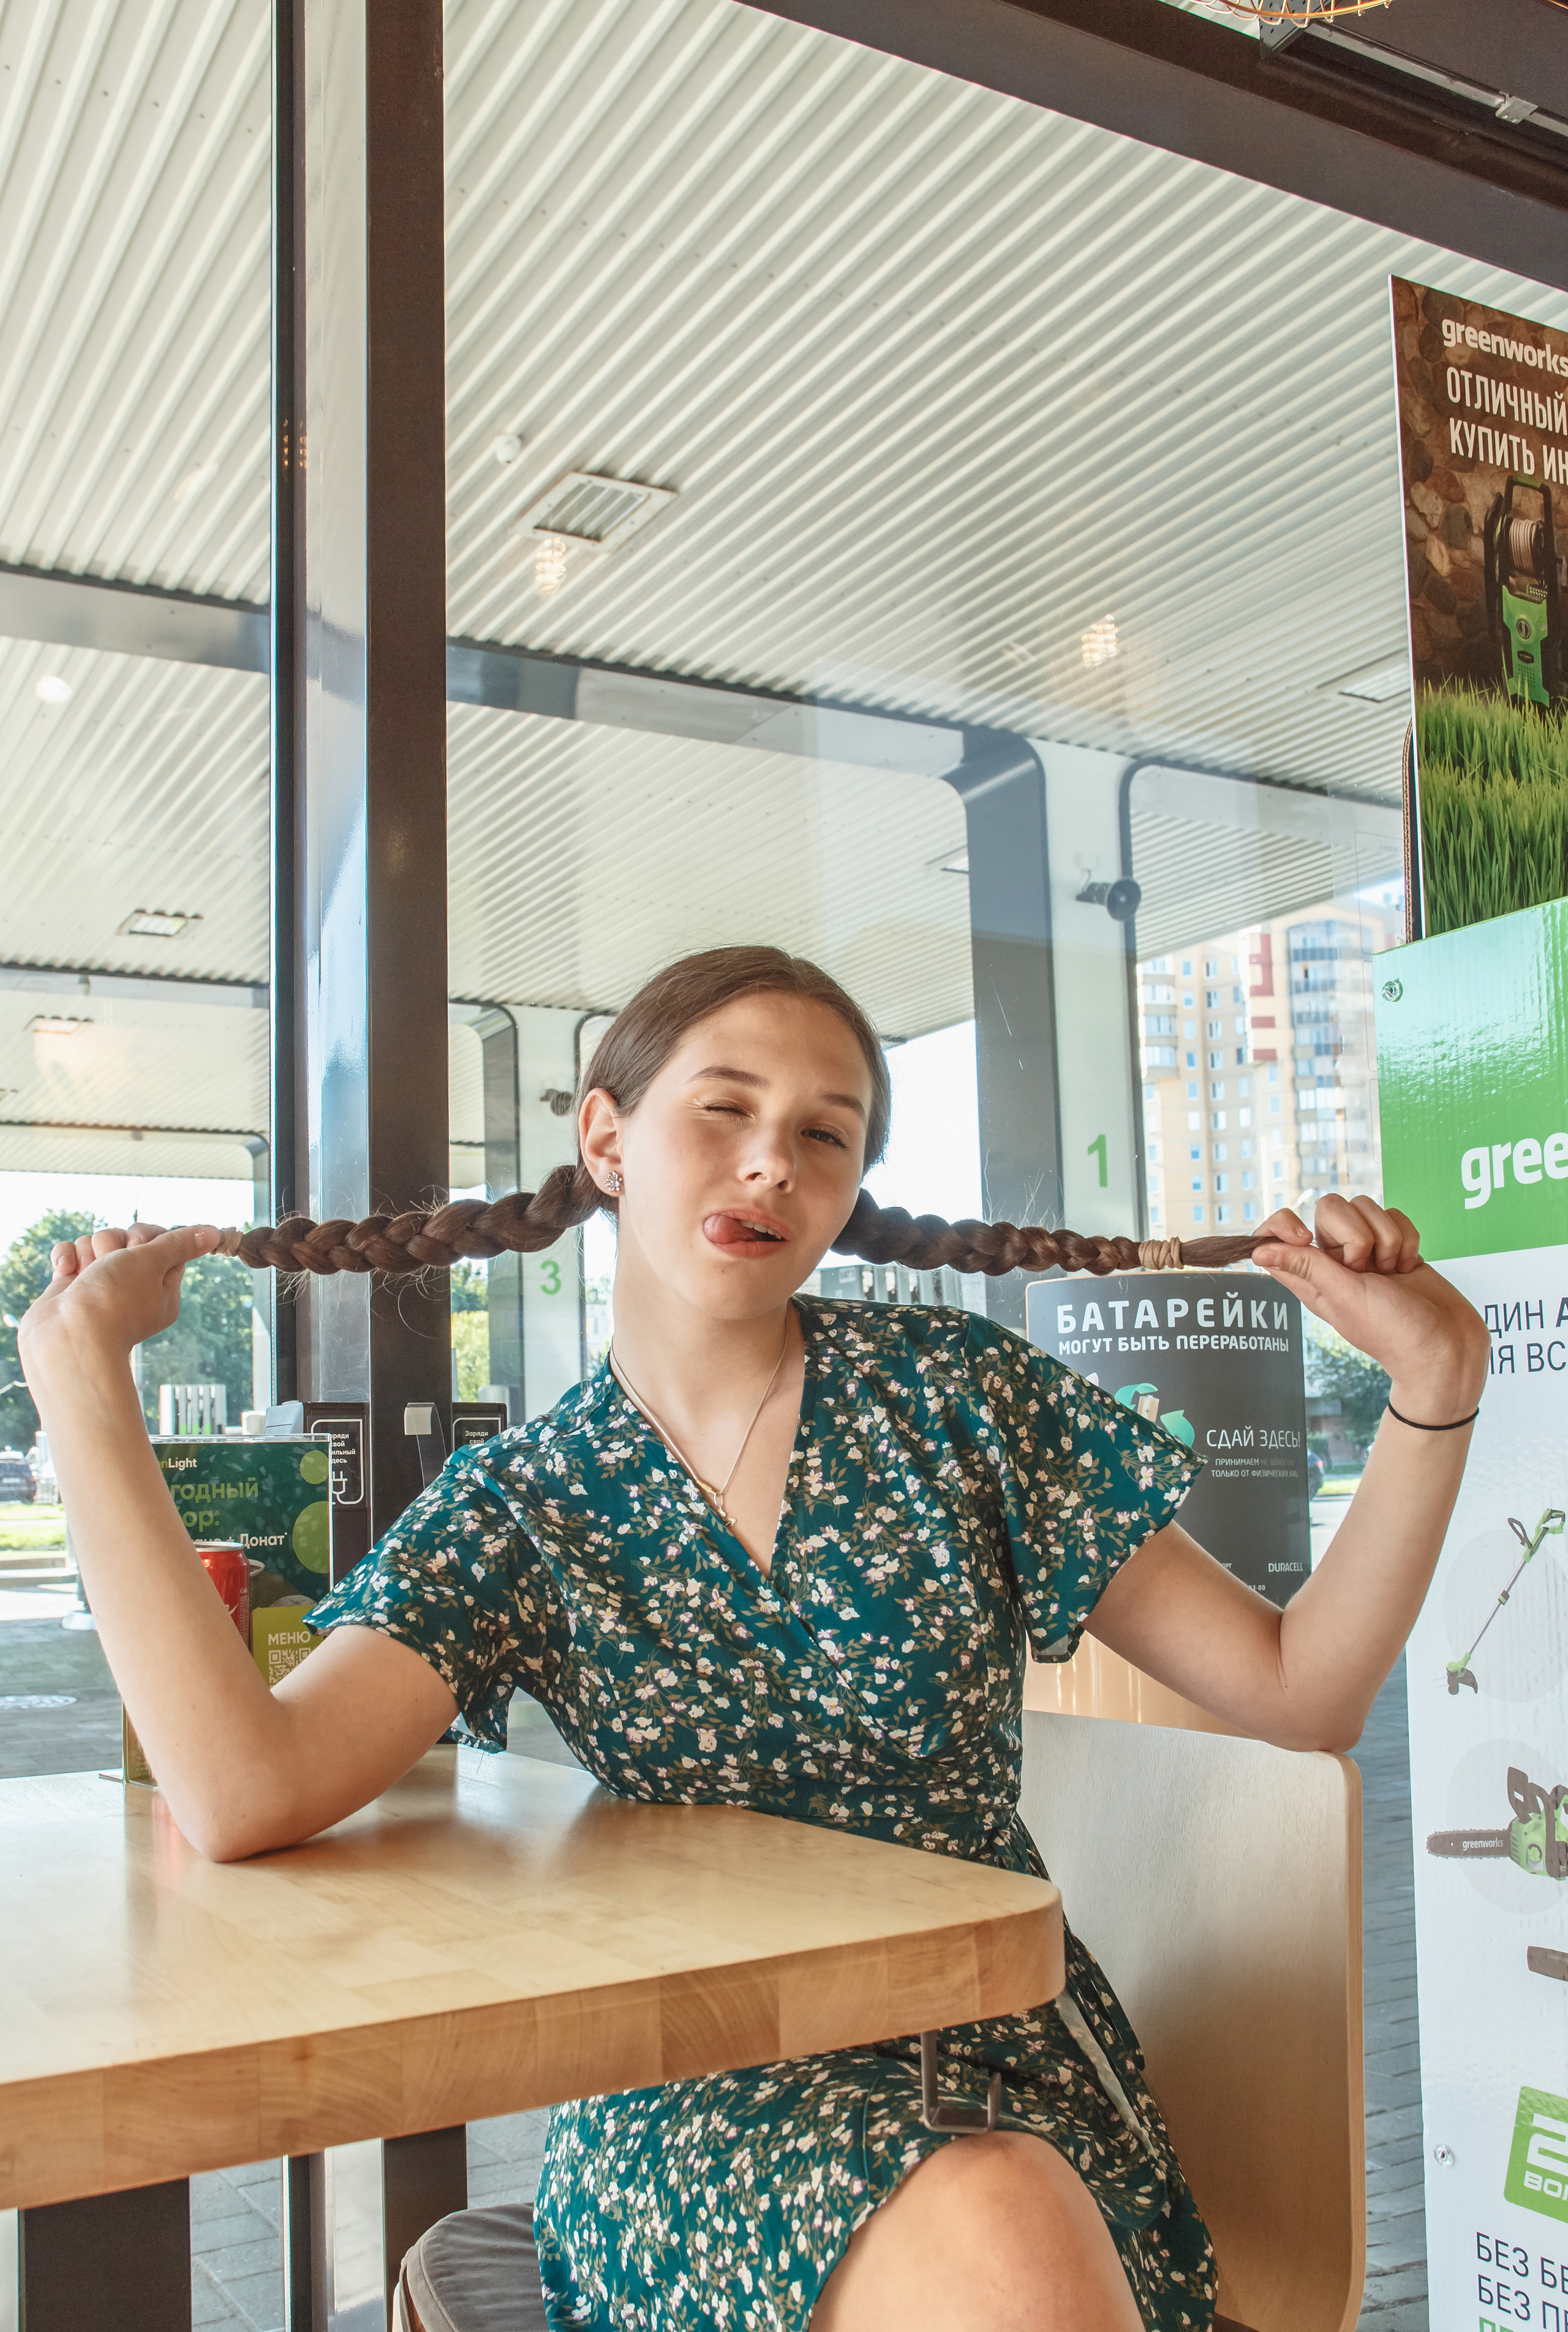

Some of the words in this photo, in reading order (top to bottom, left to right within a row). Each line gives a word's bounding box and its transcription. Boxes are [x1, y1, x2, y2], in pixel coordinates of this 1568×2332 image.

[1442, 319, 1568, 377] greenworks
[1446, 366, 1568, 436] ОТЛИЧНЫЙ
[1449, 417, 1535, 475] КУПИТЬ
[1087, 1134, 1107, 1187] 1
[1461, 1132, 1568, 1209] gree
[540, 1260, 561, 1296] 3
[1057, 1291, 1288, 1334] БАТАРЕЙКИ
[1484, 1299, 1544, 1338] ДИН
[1058, 1338, 1112, 1356] МОГУТ
[1118, 1335, 1170, 1351] БЫТЬ
[1176, 1335, 1289, 1352] ПЕРЕРАБОТАНЫ
[1526, 1340, 1567, 1372] ВС
[1206, 1425, 1254, 1449] СДАЙ
[1259, 1430, 1301, 1450] ЗДЕСЬ!
[159, 1457, 197, 1471] nLight
[170, 1477, 258, 1503] годный
[178, 1507, 220, 1532] ор:
[1268, 1562, 1303, 1572] DURACELL
[268, 1631, 311, 1645] МЕНЮ
[1462, 1837, 1504, 1851] greenworks
[1476, 2231, 1529, 2277] БЕЗ
[1477, 2273, 1531, 2321] БЕЗ
